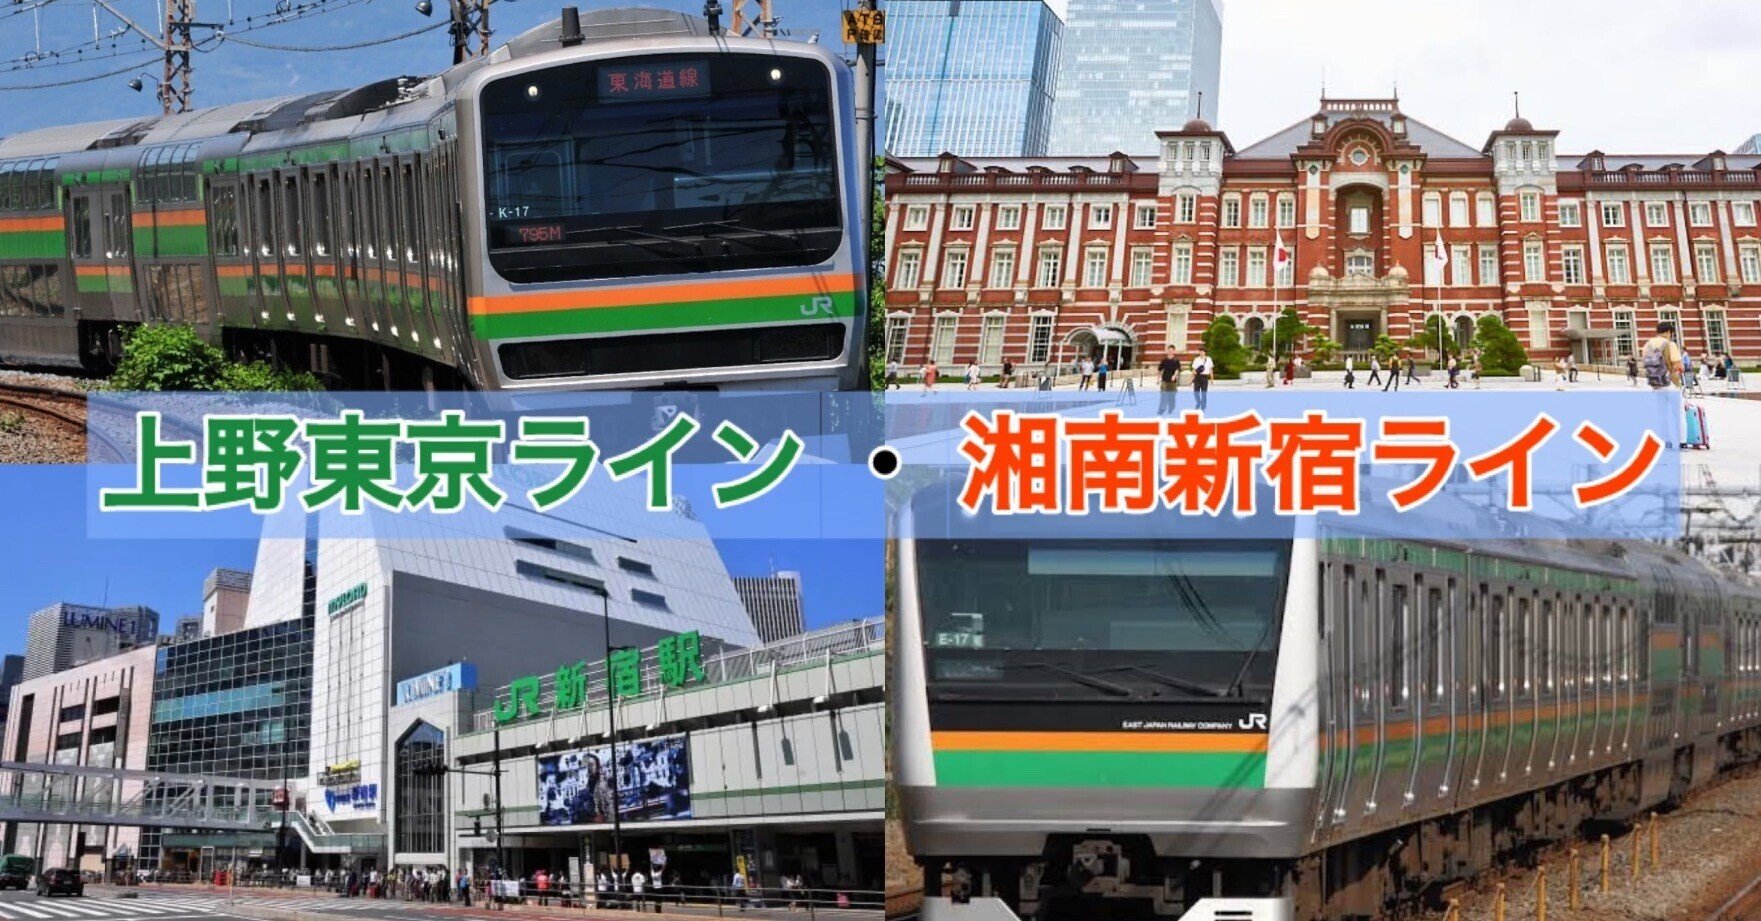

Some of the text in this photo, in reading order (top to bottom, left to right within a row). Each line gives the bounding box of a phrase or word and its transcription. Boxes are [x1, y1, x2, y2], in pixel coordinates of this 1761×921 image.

[608, 67, 699, 92] 東海道線
[498, 205, 529, 218] K-17
[519, 225, 561, 242] 795M
[800, 296, 833, 315] JR
[938, 631, 969, 646] E-17
[1122, 721, 1233, 730] EAST JAPAN RAILWAY COMPANY
[1238, 713, 1268, 730] JR
